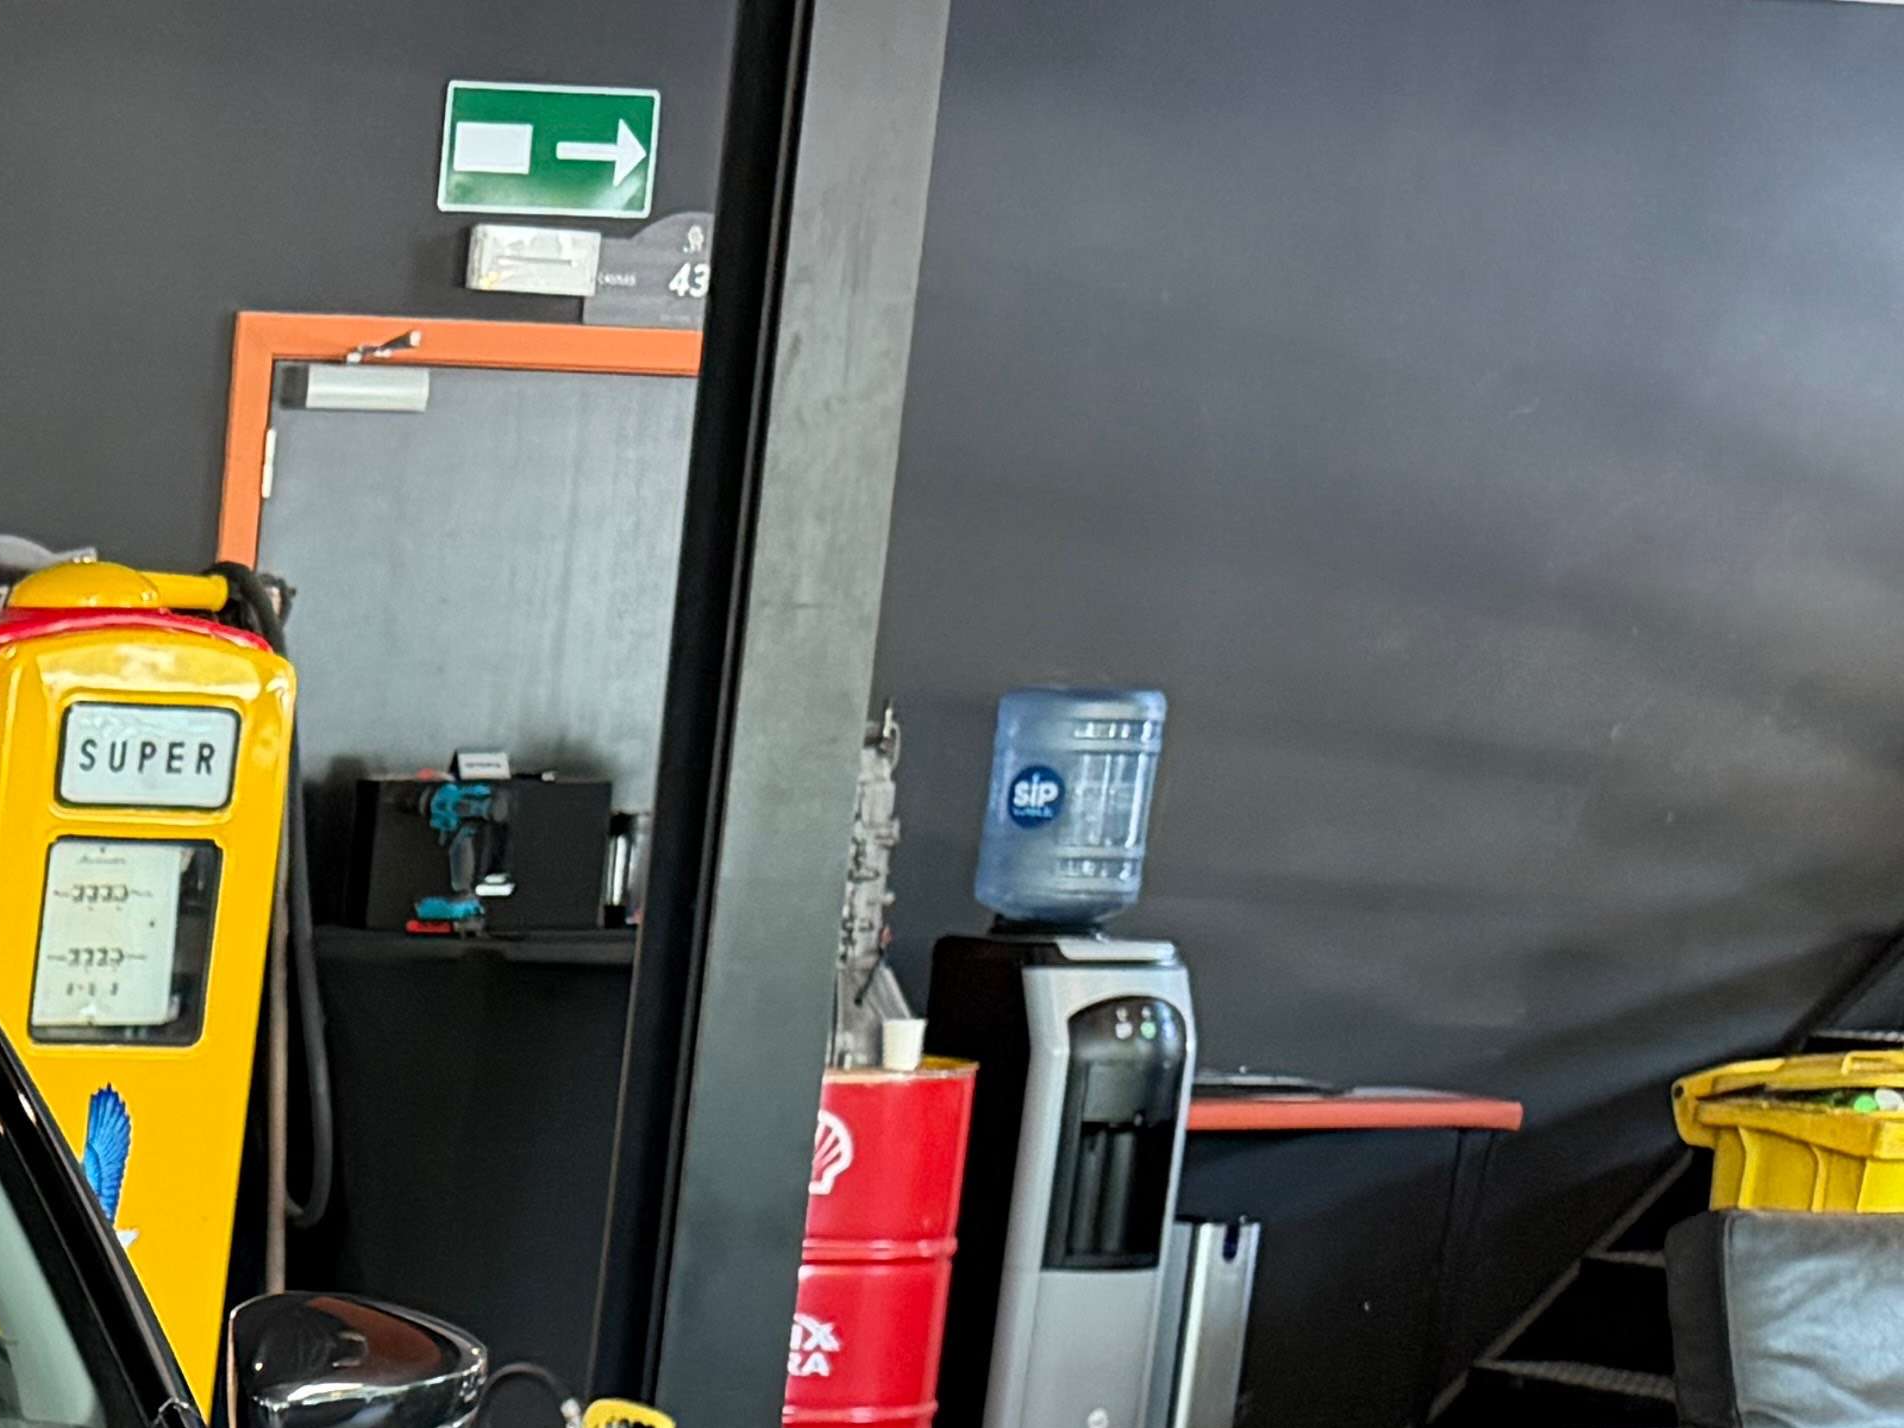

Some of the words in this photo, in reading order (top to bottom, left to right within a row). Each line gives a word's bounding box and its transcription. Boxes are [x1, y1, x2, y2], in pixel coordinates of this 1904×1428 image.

[669, 262, 710, 298] 43
[79, 738, 216, 775] SUPER
[789, 1313, 840, 1352] IX
[787, 1351, 831, 1377] RA
